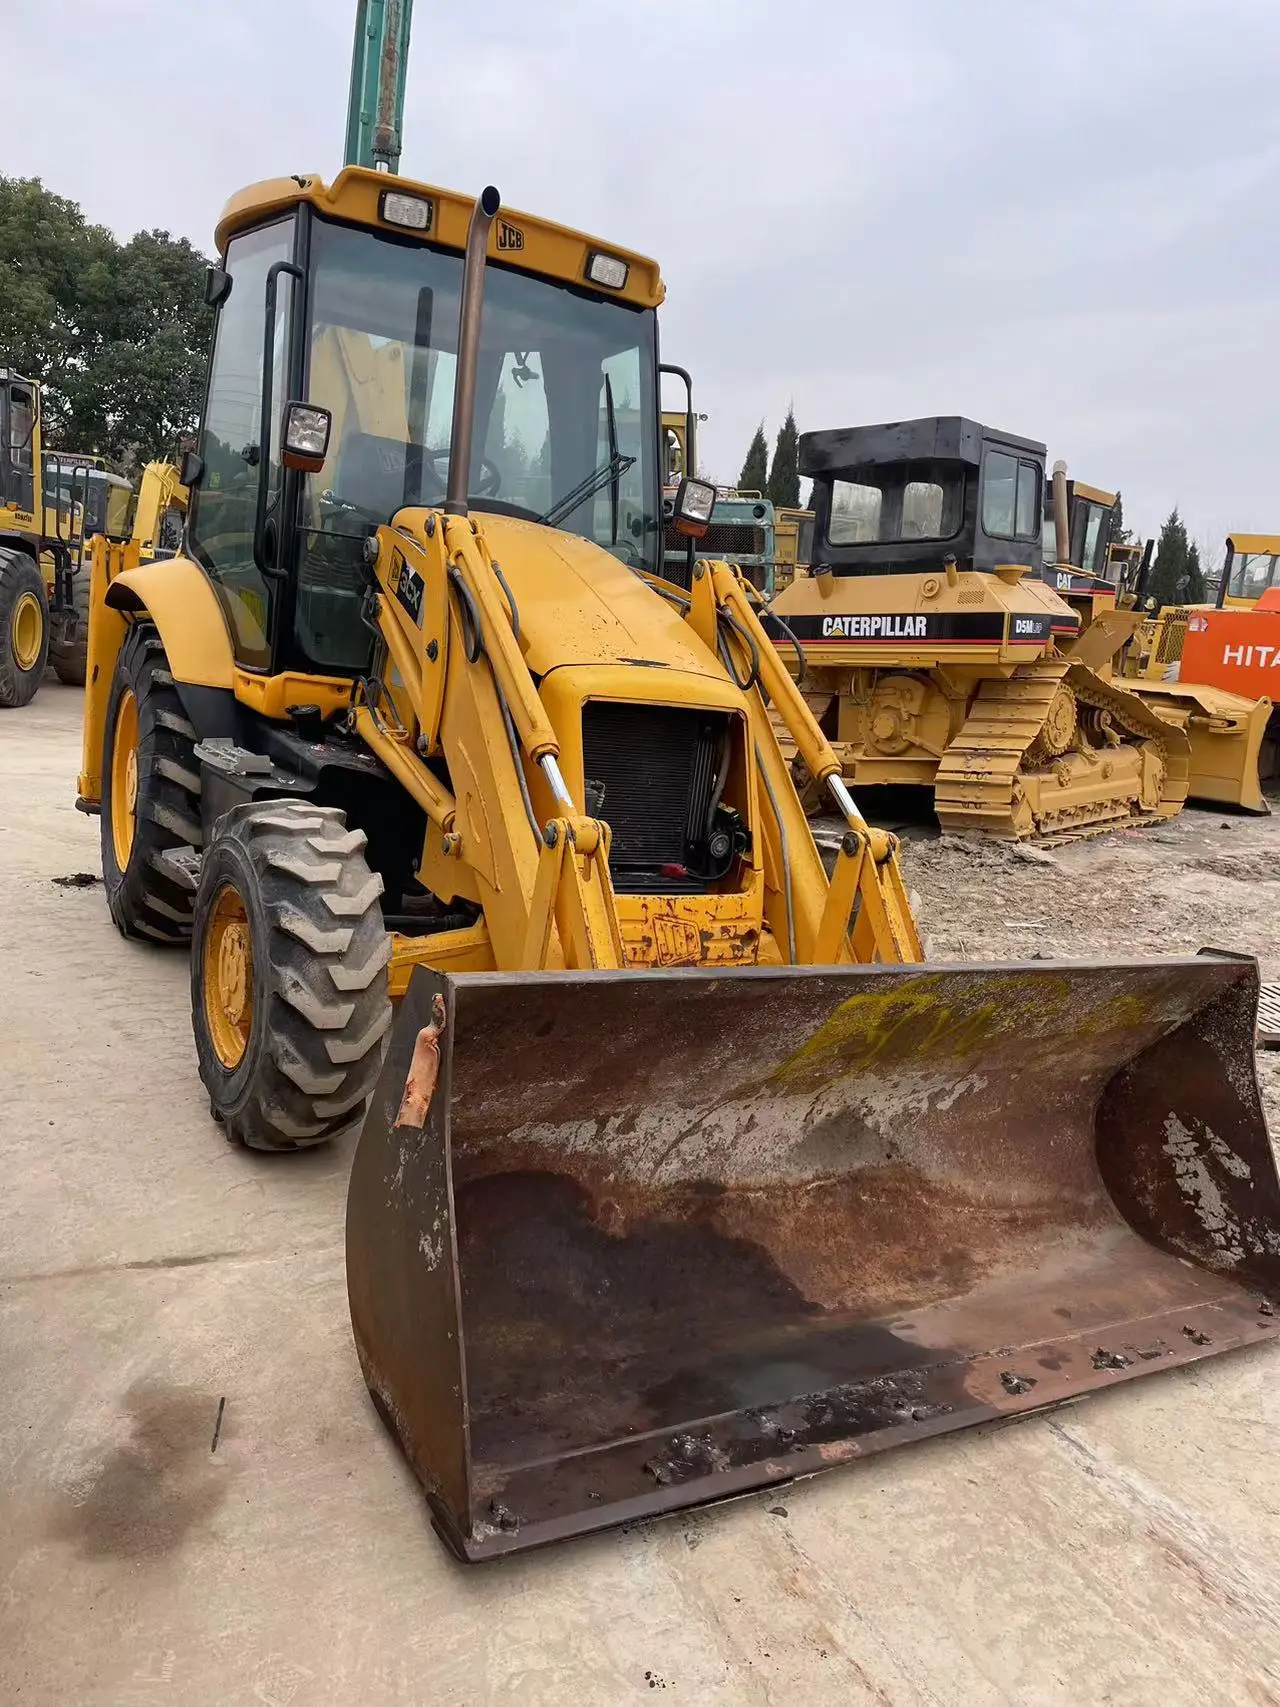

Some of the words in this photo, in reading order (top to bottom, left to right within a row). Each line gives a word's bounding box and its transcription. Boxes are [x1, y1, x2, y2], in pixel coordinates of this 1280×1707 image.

[499, 222, 522, 248] JCB
[1056, 572, 1073, 590] CAT
[822, 616, 927, 637] CATERPILLAR
